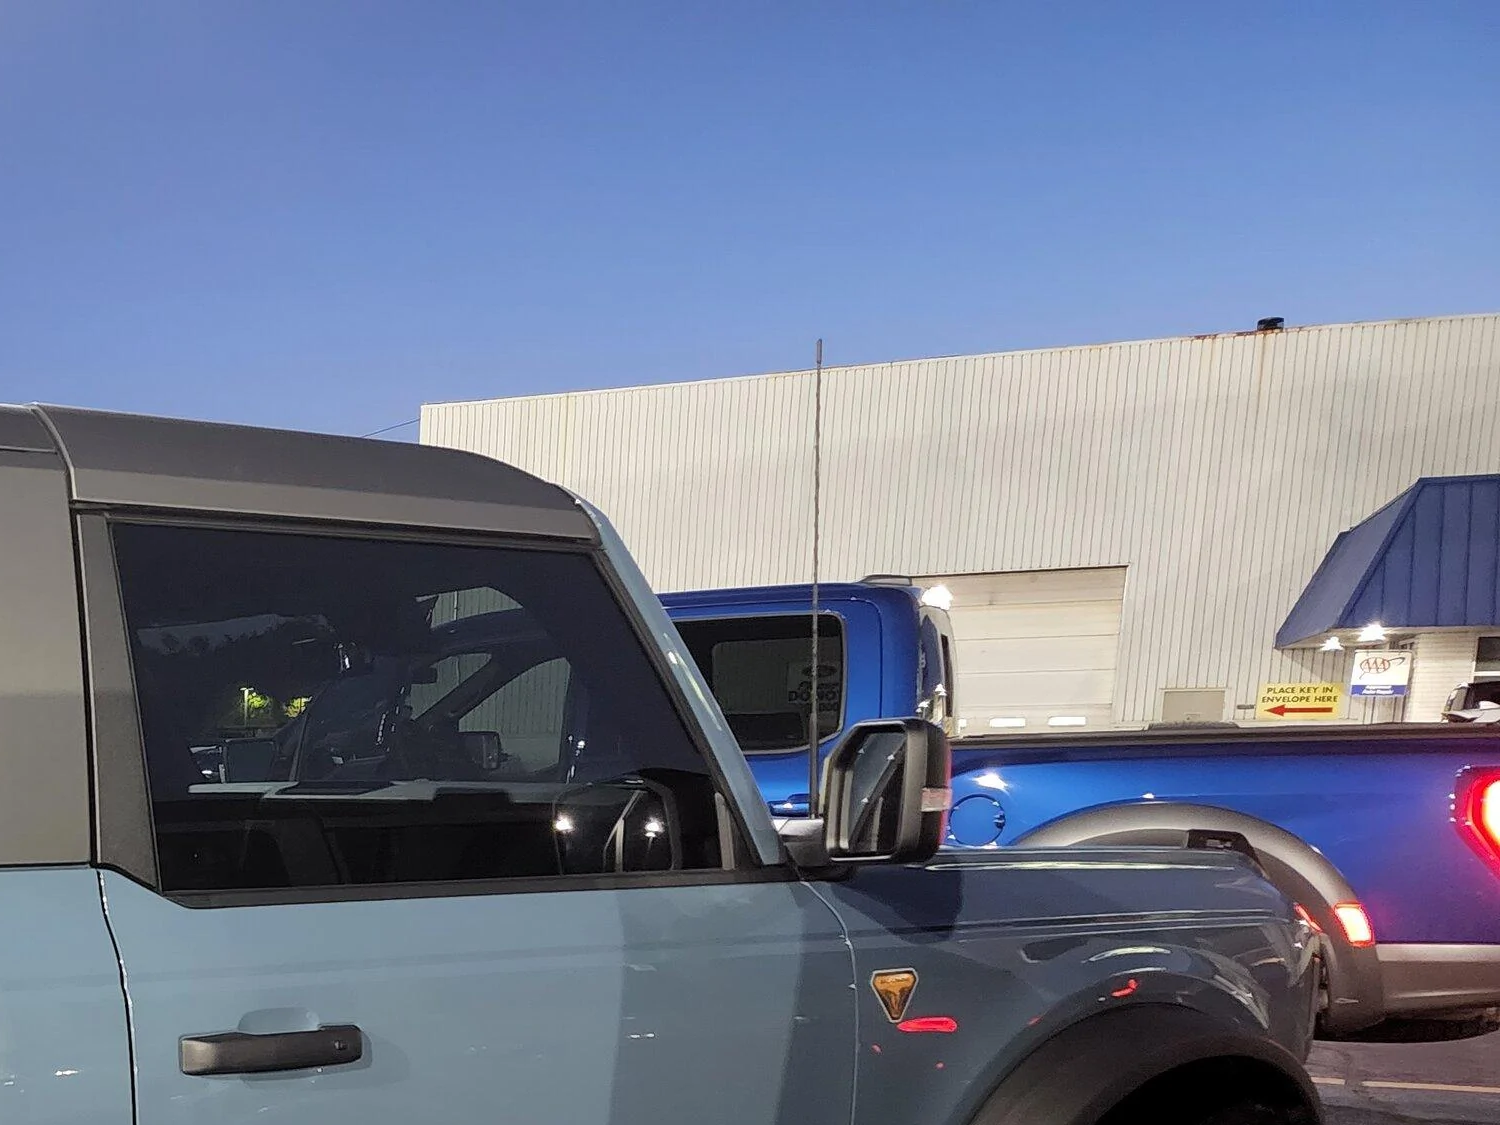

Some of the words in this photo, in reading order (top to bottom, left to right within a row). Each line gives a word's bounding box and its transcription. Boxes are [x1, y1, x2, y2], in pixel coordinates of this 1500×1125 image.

[1266, 686, 1296, 695] PLACE
[1300, 686, 1319, 694] KEY
[1261, 695, 1311, 704] ENVELOPE
[1314, 695, 1338, 703] HERE
